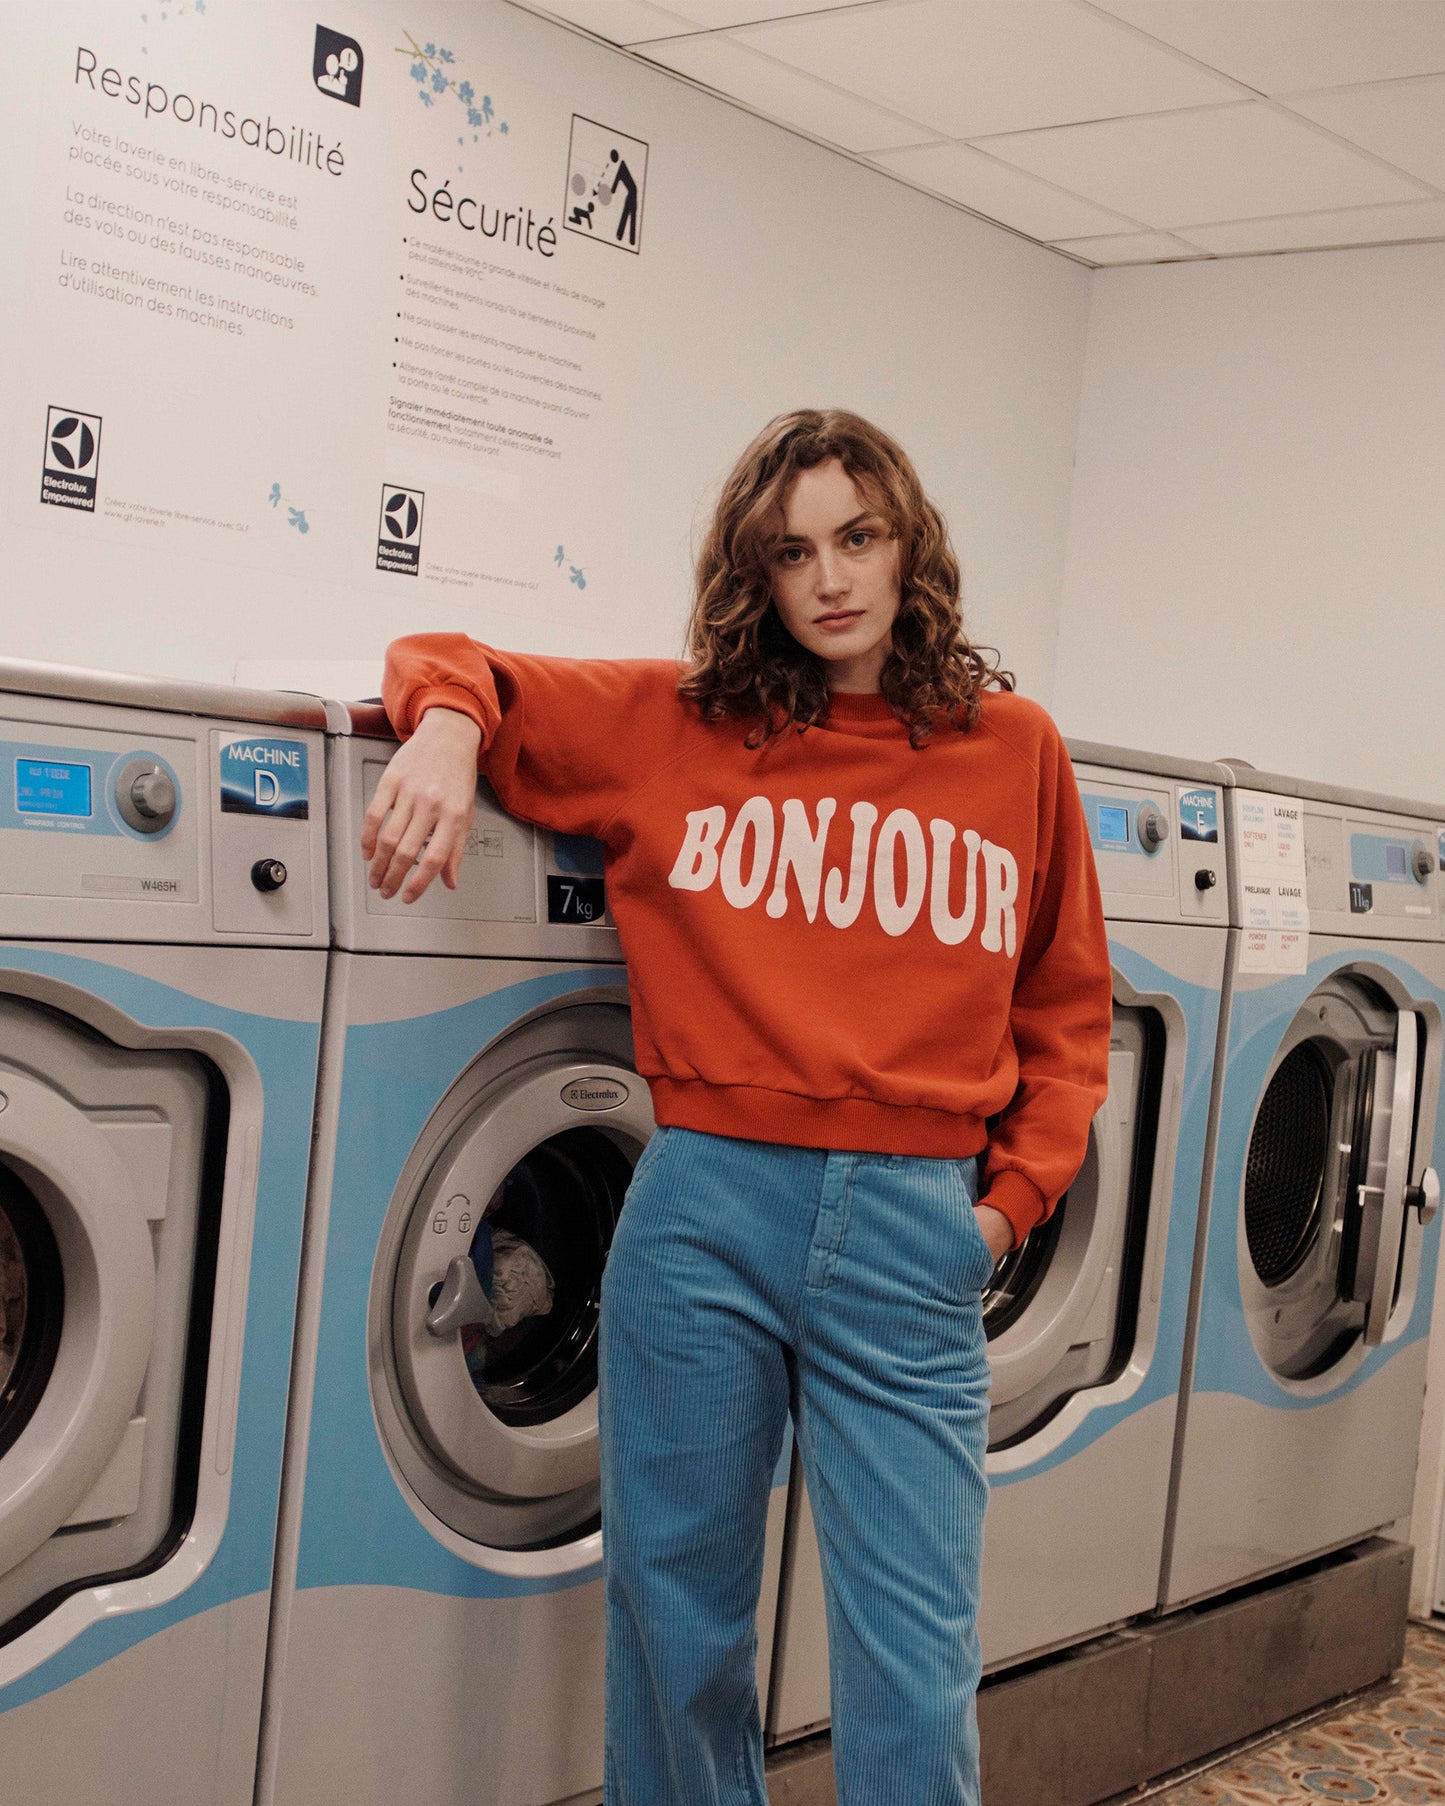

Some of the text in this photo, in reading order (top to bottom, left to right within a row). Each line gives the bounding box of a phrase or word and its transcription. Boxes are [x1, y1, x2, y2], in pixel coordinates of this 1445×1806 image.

[75, 46, 345, 176] Responsabilité
[72, 120, 297, 209] Votre laverie en libre-service est
[69, 146, 297, 229] placée sous votre responsabilité
[408, 168, 557, 257] Sécurité
[63, 209, 91, 228] des
[94, 220, 124, 238] vols
[127, 229, 146, 245] ou
[149, 234, 175, 254] des
[179, 242, 230, 270] fausses
[66, 185, 304, 272] La direction n'est pas responsable
[60, 249, 293, 329] Lire attentivement les instructions
[58, 273, 245, 335] d'utilisation des machines.
[43, 475, 87, 494] Electrolux
[42, 488, 94, 508] Empowered
[377, 556, 417, 573] Empowered
[379, 545, 413, 560] Electrolux
[228, 744, 300, 768] MACHINE
[255, 769, 280, 807] D
[1183, 795, 1213, 808] MACHINE
[1274, 808, 1298, 820] LAVAGE
[141, 880, 177, 892] W465H
[668, 796, 1019, 958] BONJOUR
[1244, 885, 1271, 896] PRELAVAGE
[1278, 887, 1302, 898] LAVAGE
[580, 1089, 619, 1100] Electrolux
